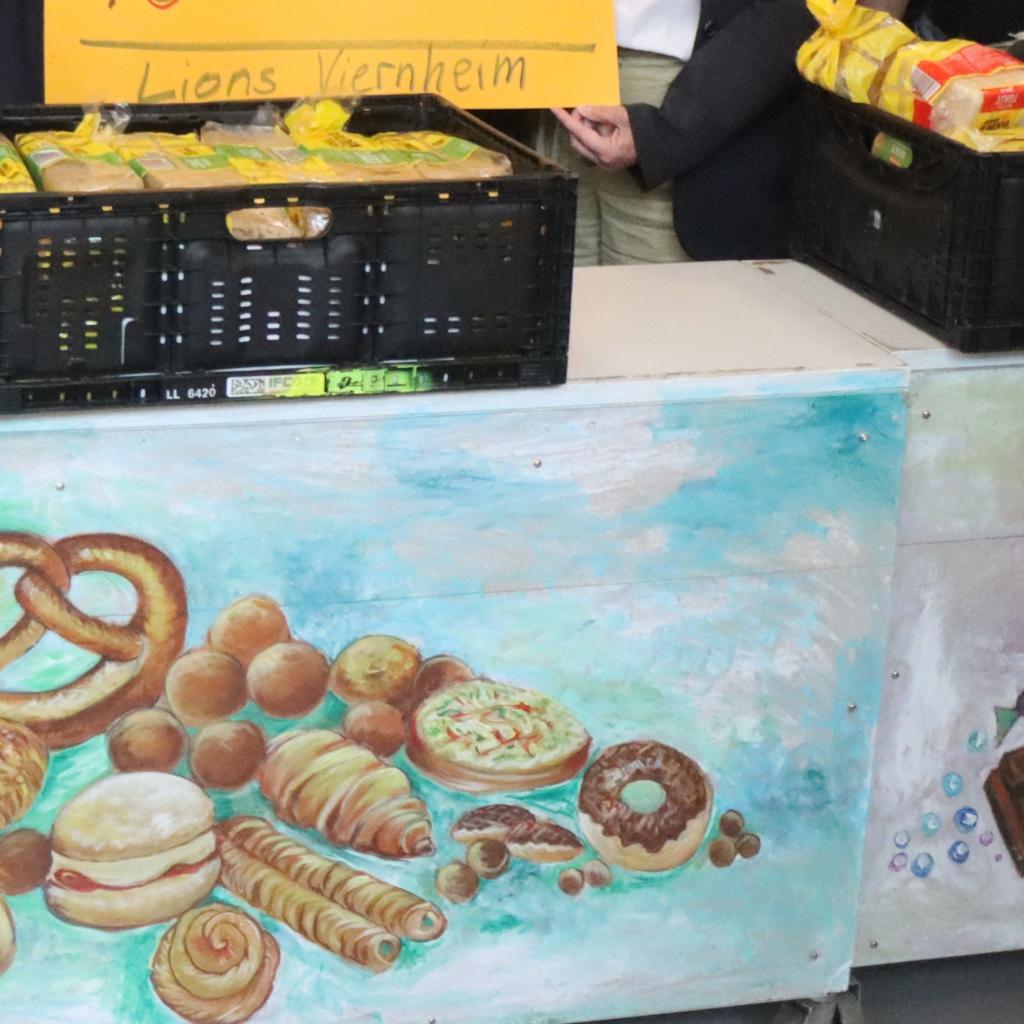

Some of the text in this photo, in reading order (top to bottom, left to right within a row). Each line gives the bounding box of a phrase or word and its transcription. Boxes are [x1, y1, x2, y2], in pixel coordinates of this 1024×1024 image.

[137, 44, 527, 103] Lions Viernheim
[165, 387, 216, 400] LL 6420
